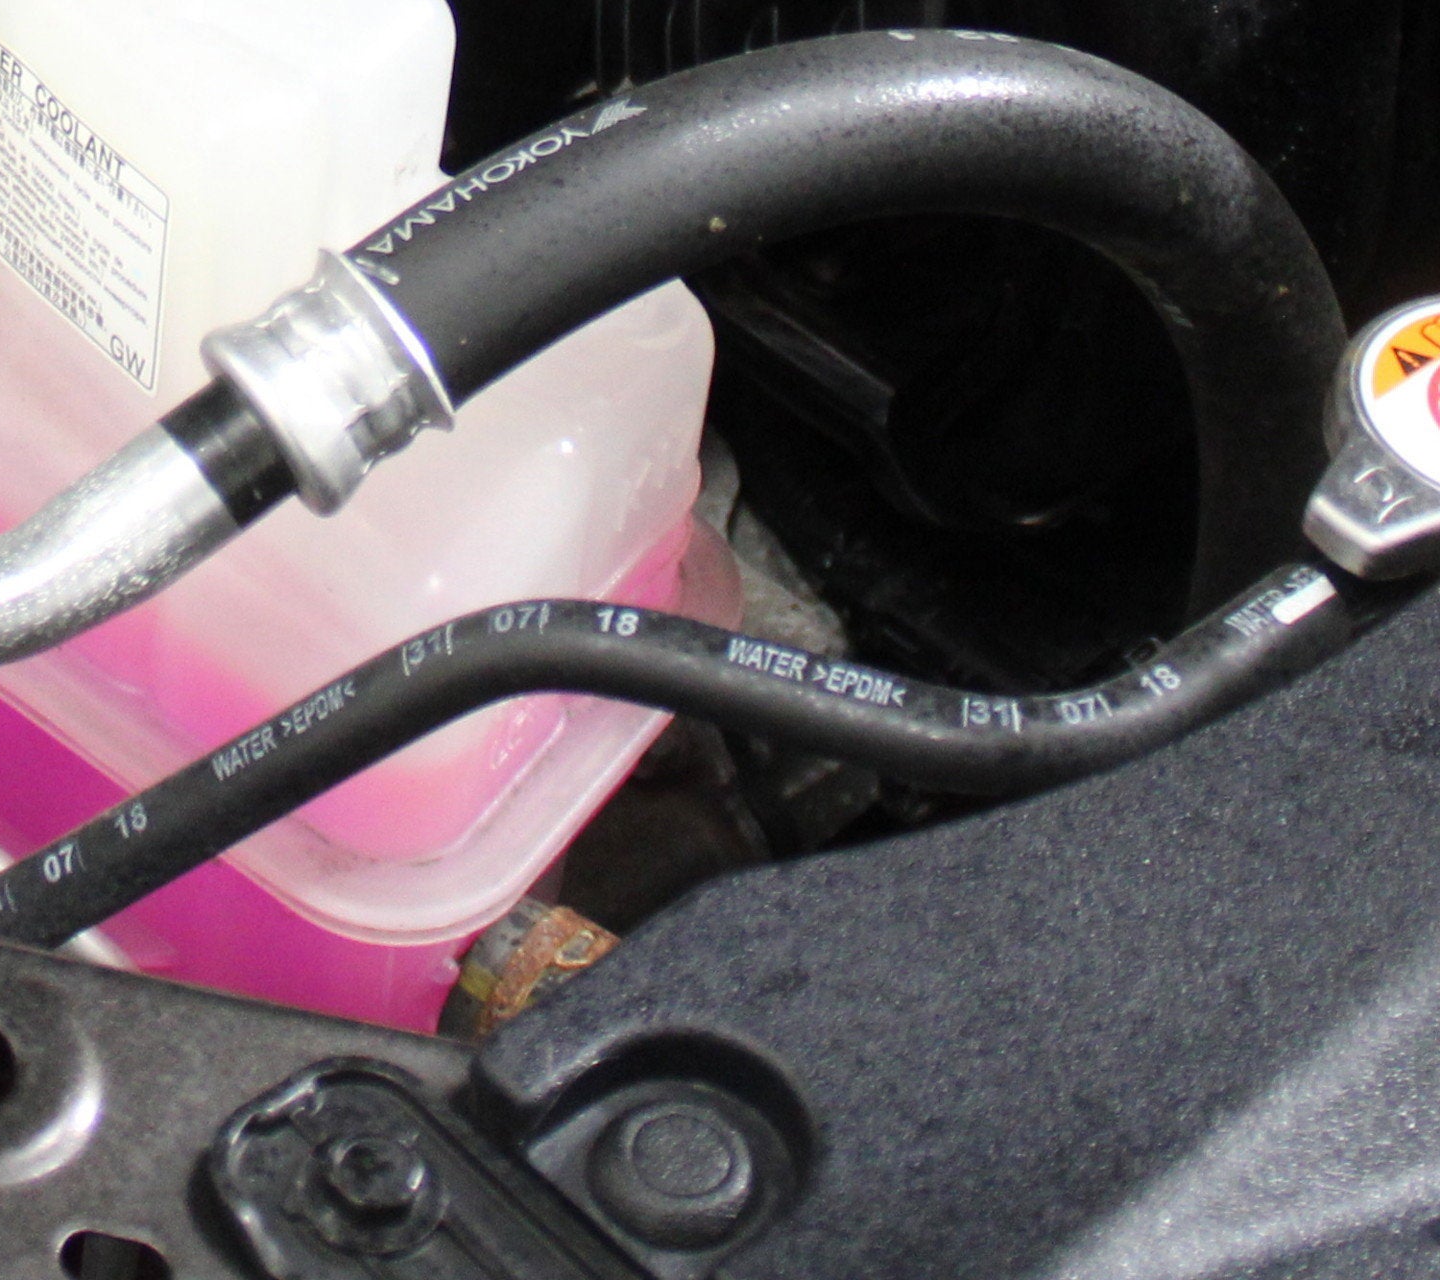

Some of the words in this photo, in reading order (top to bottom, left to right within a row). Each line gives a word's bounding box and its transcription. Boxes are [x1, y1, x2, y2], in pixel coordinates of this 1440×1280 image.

[35, 83, 125, 180] COOLANT
[365, 126, 590, 254] YOKOHAMA
[109, 334, 146, 380] GW
[597, 607, 640, 637] 18
[726, 638, 808, 682] WATER
[1138, 663, 1182, 697] 18
[212, 725, 278, 781] WATER
[114, 802, 148, 839] 18
